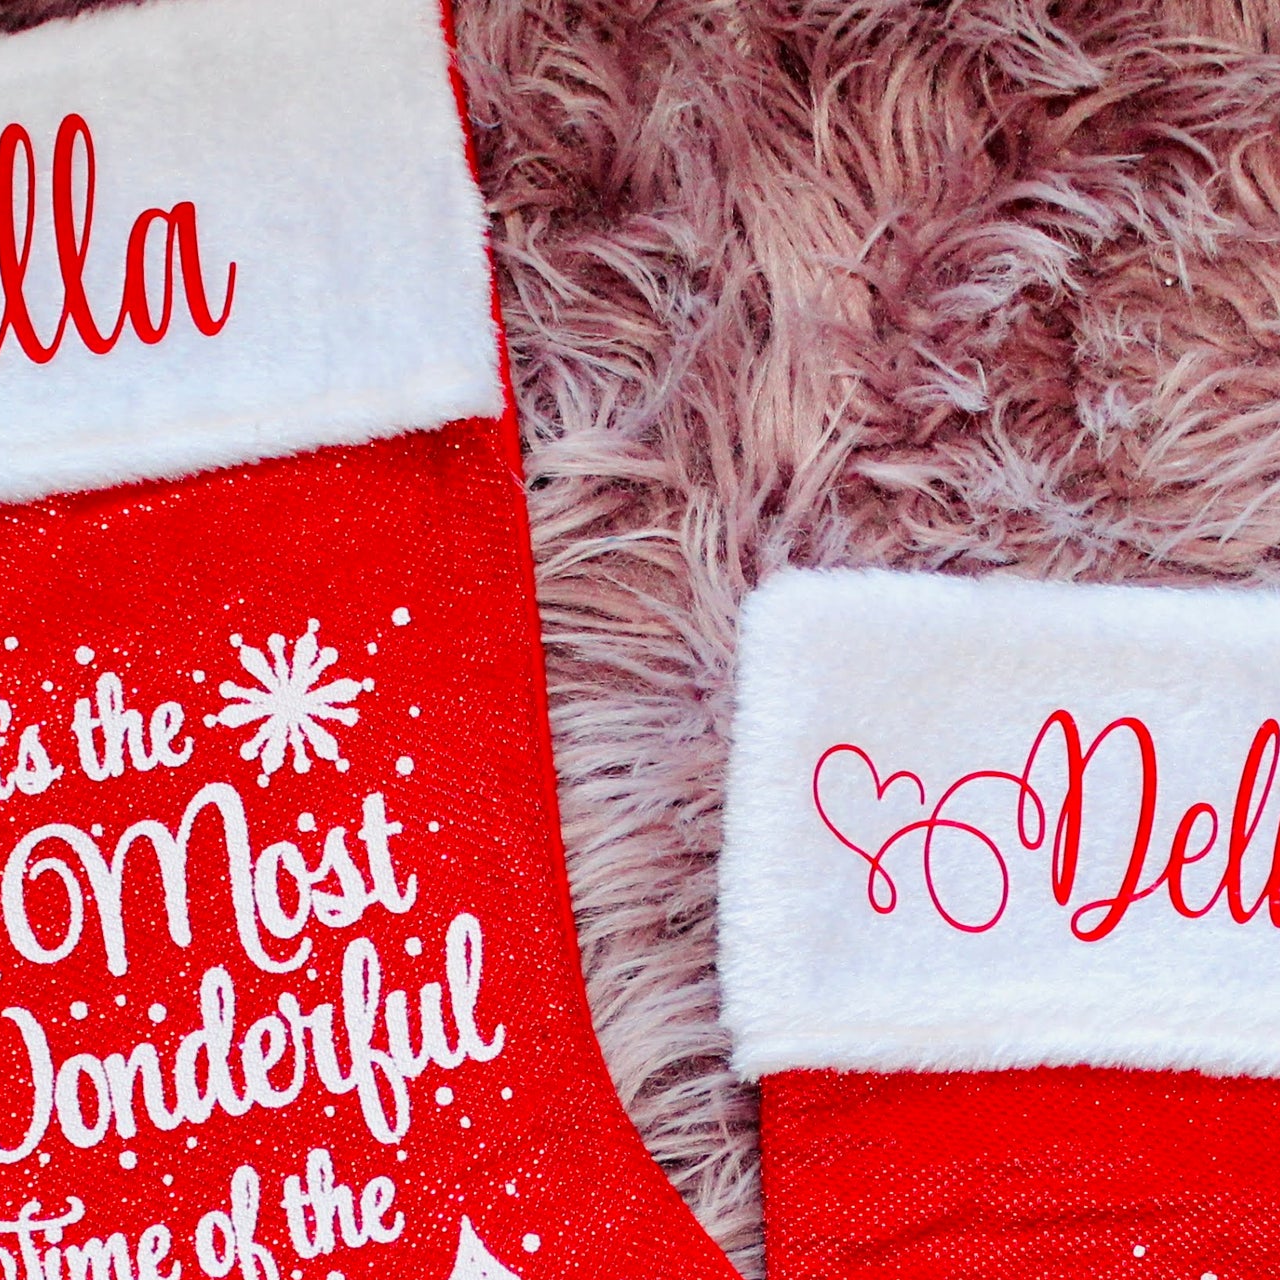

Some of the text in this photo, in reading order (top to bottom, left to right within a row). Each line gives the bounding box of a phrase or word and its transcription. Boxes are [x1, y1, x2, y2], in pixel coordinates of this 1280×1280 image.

[71, 672, 194, 782] the
[0, 782, 418, 977] Most
[280, 1148, 405, 1259] the
